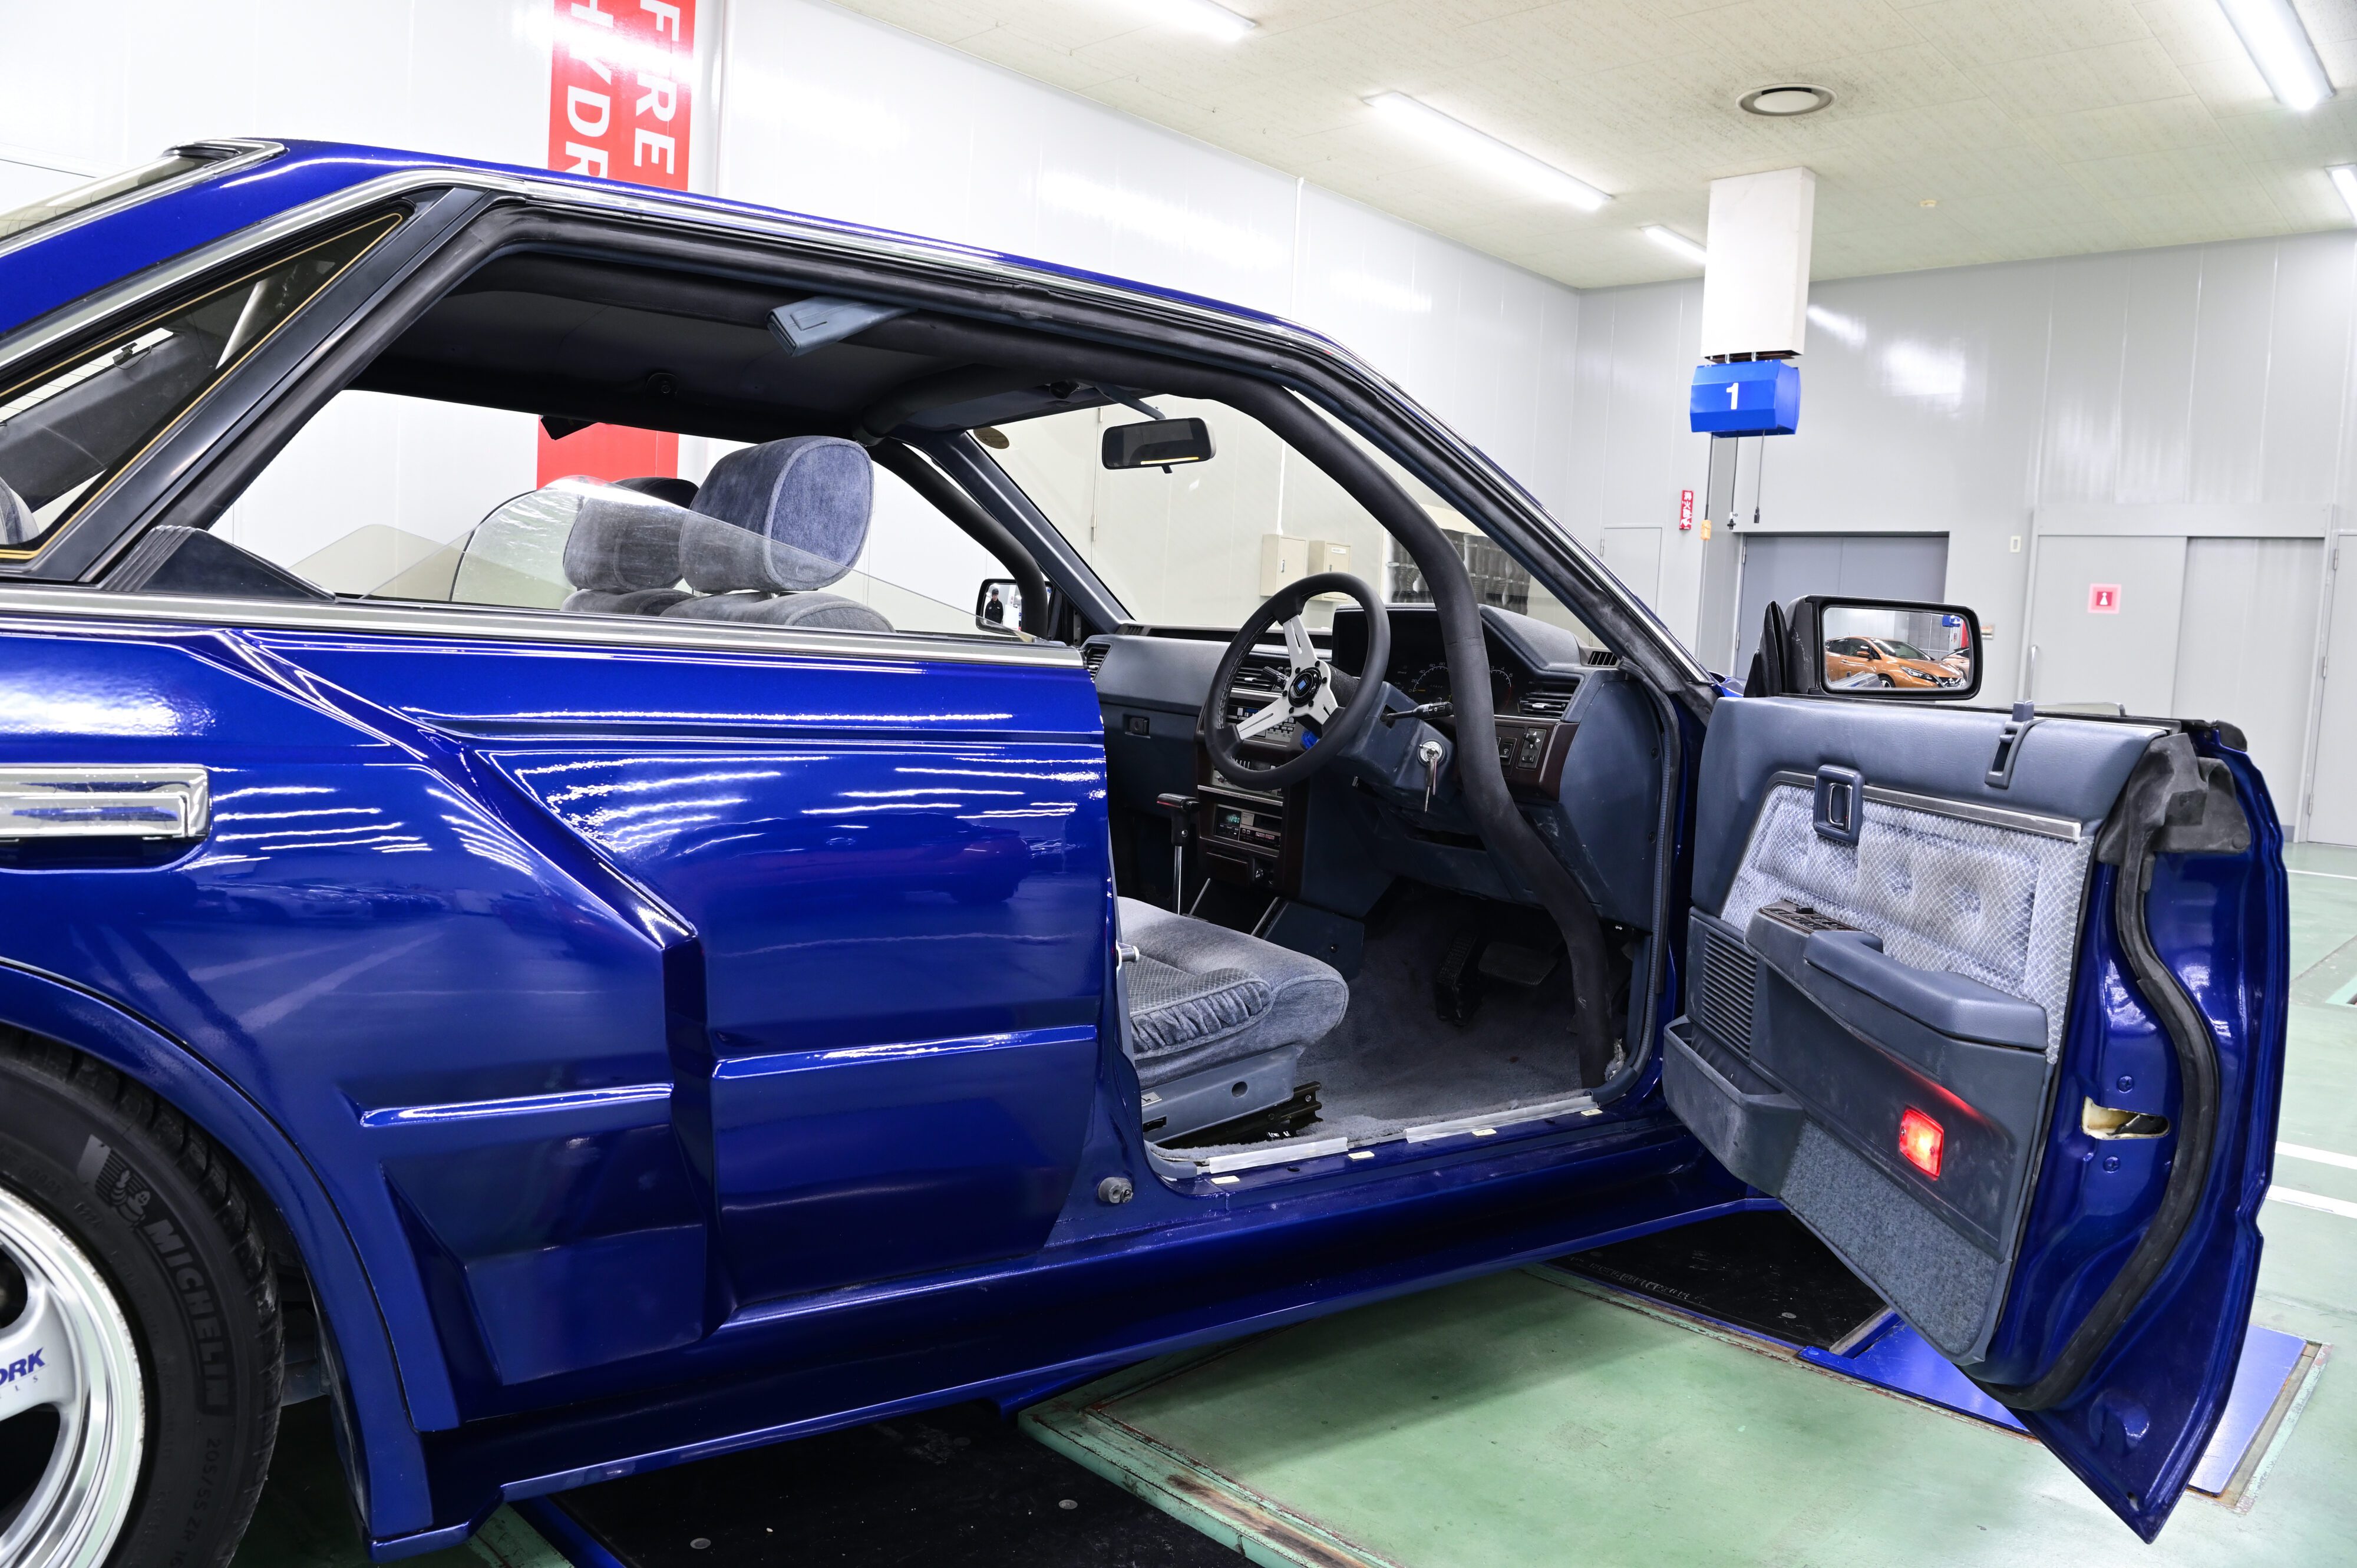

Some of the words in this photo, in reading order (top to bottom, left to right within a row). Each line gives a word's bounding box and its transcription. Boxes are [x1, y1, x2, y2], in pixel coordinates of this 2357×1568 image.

[633, 0, 681, 175] FRE
[1726, 382, 1739, 410] 1
[144, 1219, 230, 1406] MICHELIN
[193, 1438, 222, 1511] 205/55
[182, 1516, 203, 1543] ZR
